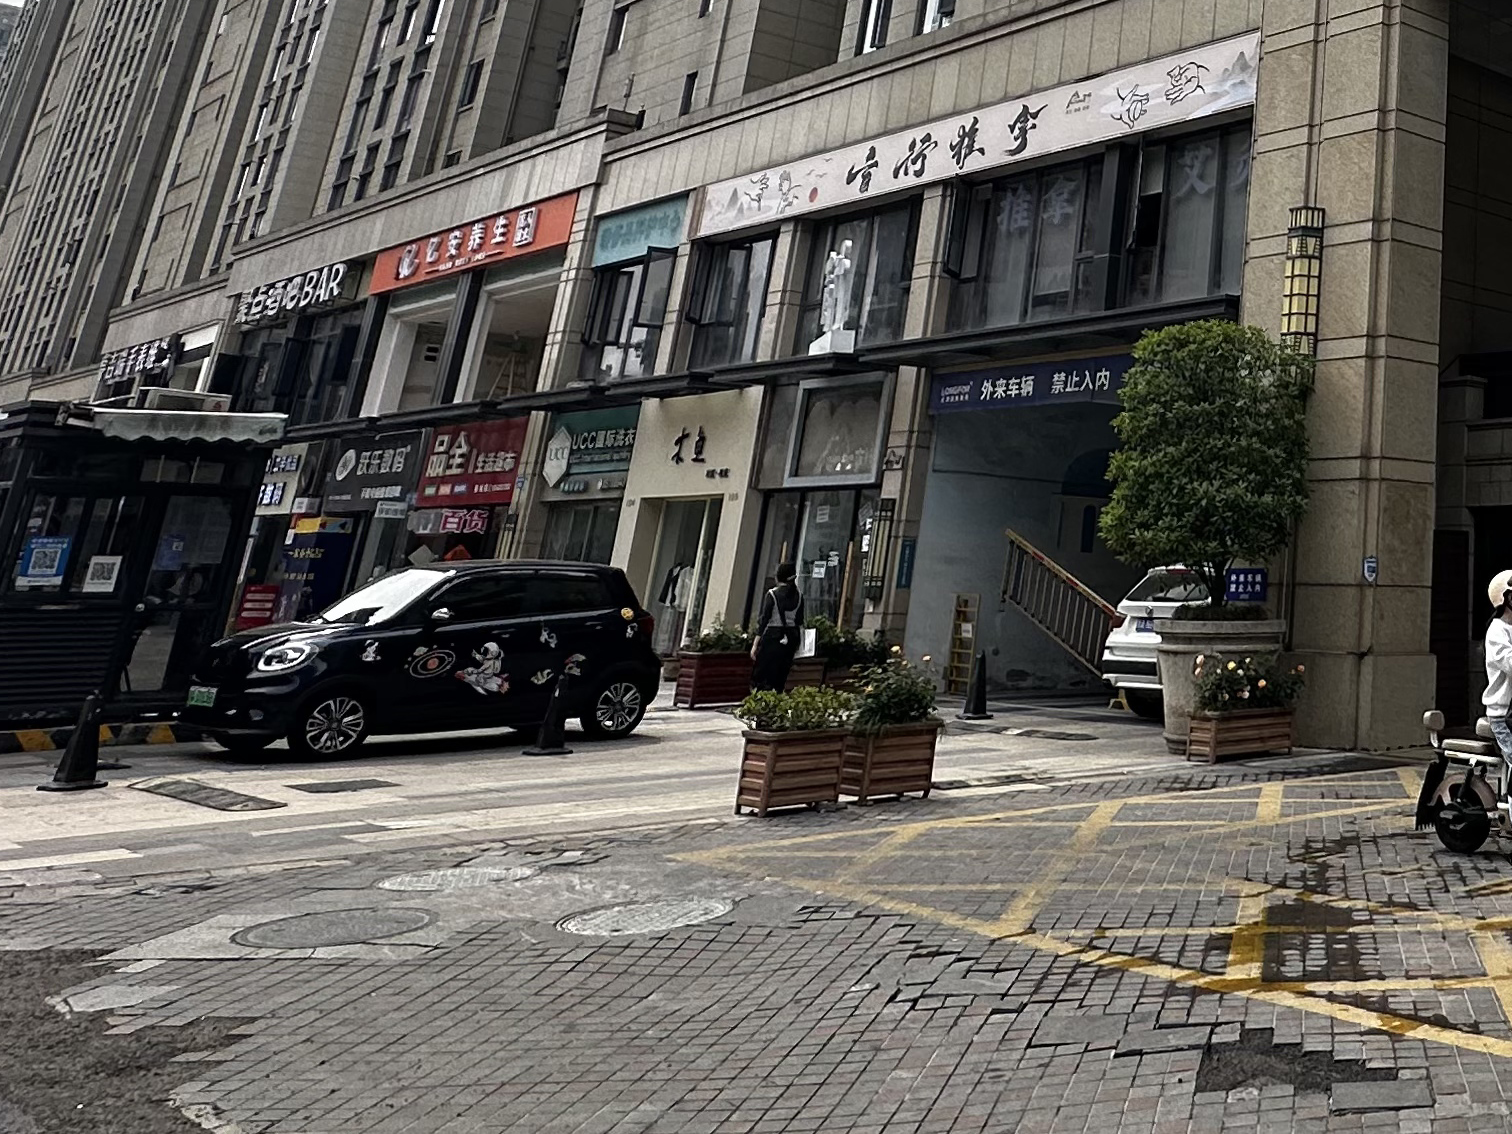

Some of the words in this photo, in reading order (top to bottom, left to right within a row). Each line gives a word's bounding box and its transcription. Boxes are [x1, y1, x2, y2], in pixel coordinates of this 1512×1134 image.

[980, 375, 1035, 401] 外来车辆
[1050, 368, 1110, 394] 禁止入内
[440, 508, 489, 534] 百货
